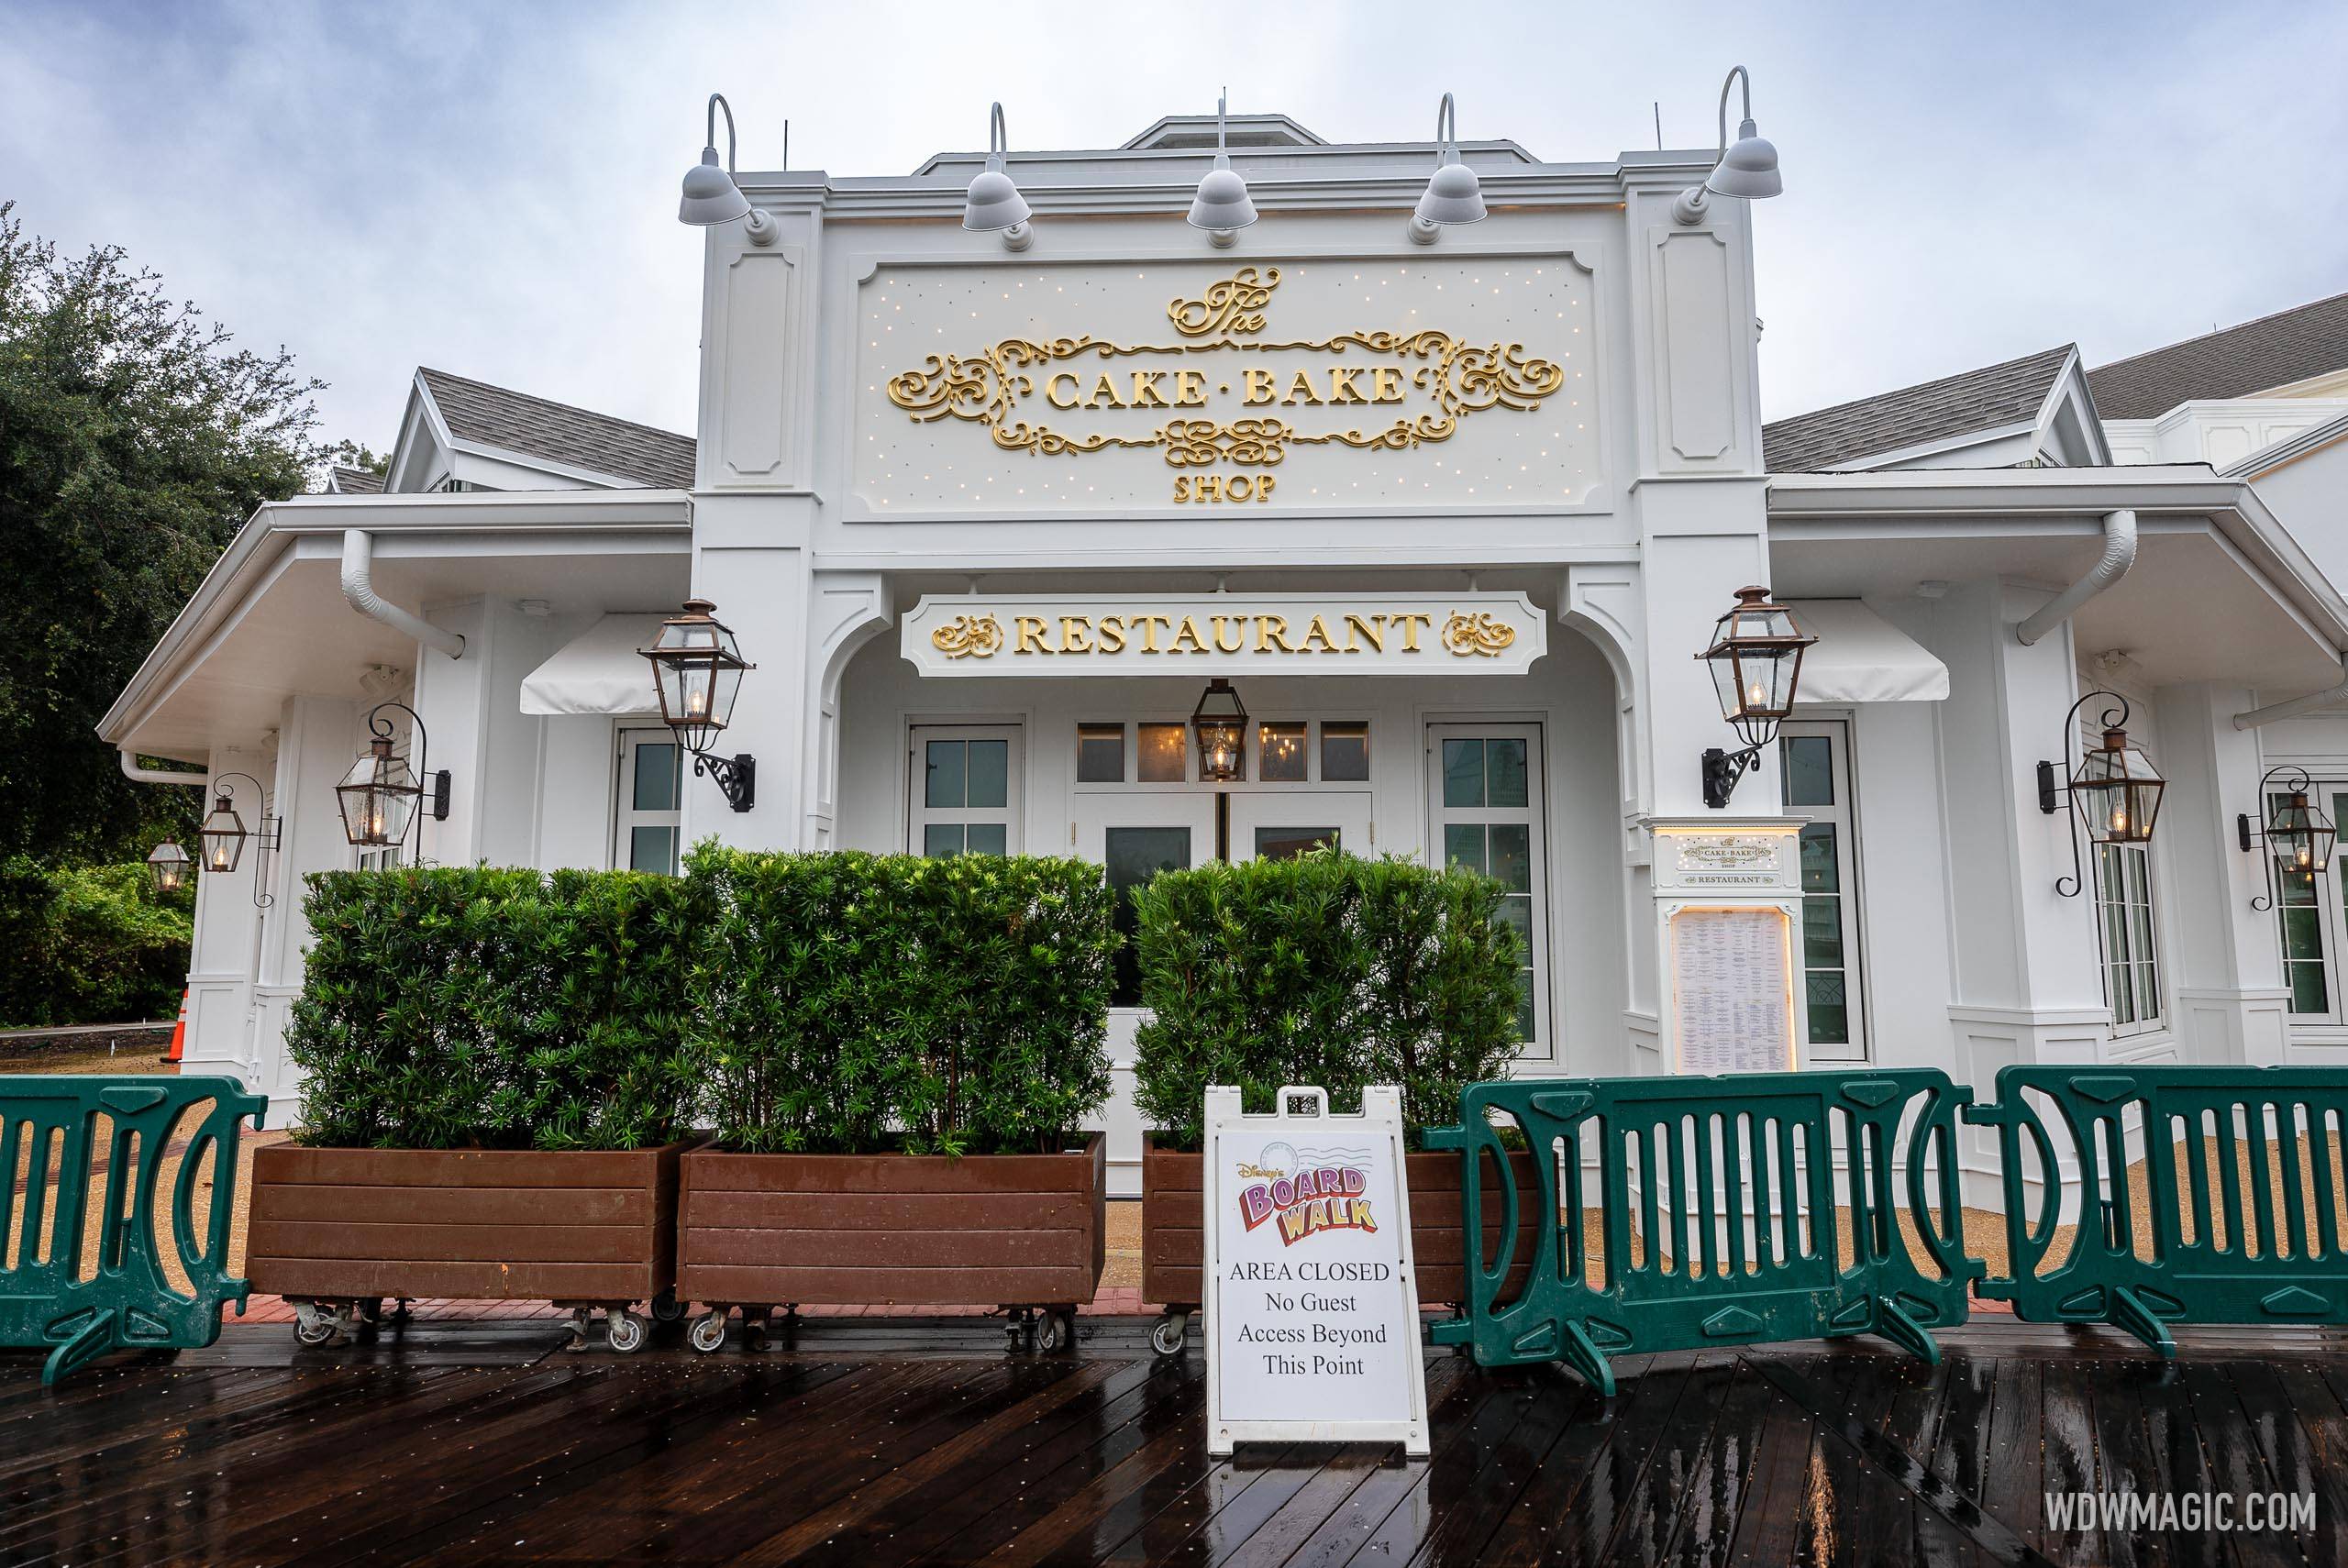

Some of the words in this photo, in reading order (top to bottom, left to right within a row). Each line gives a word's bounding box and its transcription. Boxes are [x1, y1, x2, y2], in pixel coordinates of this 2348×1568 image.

[1168, 266, 1281, 337] The
[1046, 370, 1208, 410] CAKE
[1242, 368, 1406, 407] BAKE
[1173, 475, 1276, 503] SHOP
[1013, 613, 1431, 655] RESTAURANT
[1239, 1167, 1366, 1232] BOARD
[1277, 1198, 1378, 1247] WALK
[1230, 1262, 1293, 1281] AREA
[1299, 1262, 1390, 1282] CLOSED
[1265, 1293, 1294, 1311] No
[1301, 1292, 1357, 1311] Guest
[1238, 1324, 1306, 1343] Access
[1312, 1324, 1387, 1348] Beyond
[1263, 1354, 1306, 1375] This
[1313, 1354, 1364, 1375] Point
